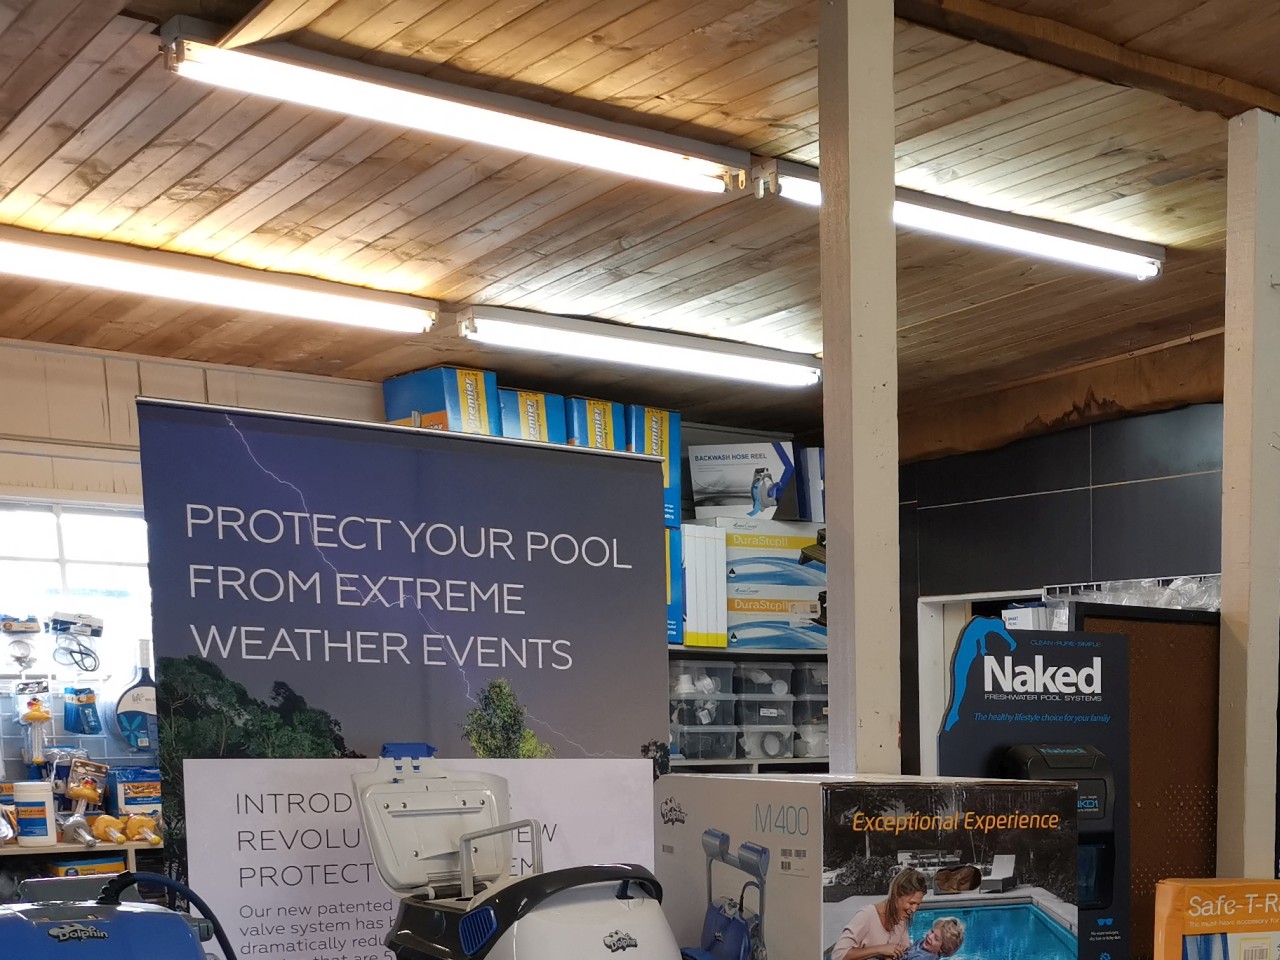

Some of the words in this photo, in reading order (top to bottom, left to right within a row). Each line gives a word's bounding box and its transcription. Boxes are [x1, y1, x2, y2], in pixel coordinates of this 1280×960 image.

[464, 377, 477, 428] Premier
[525, 399, 537, 440] remier
[593, 407, 603, 448] remier
[649, 415, 660, 456] remier
[694, 454, 731, 462] BACKWASH
[186, 503, 391, 552] PROTECT
[399, 520, 513, 561] YOUR
[526, 531, 633, 570] POOL
[189, 564, 321, 606] FROM
[336, 573, 526, 616] EXTREME
[189, 624, 410, 665] WEATHER
[423, 634, 573, 671] EVENTS
[984, 654, 1102, 694] Naked
[974, 712, 988, 721] The
[988, 712, 1014, 723] healthy
[1014, 713, 1040, 722] lifestyle
[1041, 713, 1064, 721] choice
[1064, 714, 1074, 722] for
[1073, 715, 1089, 723] your
[1089, 714, 1111, 723] family
[235, 792, 353, 815] INTROD
[852, 811, 959, 837] Exceptional
[964, 810, 1060, 835] Experience
[237, 829, 360, 852] REVOLU
[239, 863, 375, 888] PROTECT
[239, 904, 273, 919] Our
[277, 906, 312, 918] new
[317, 899, 393, 918] patented
[58, 927, 109, 942] Dolphin
[239, 921, 286, 937] valve
[290, 920, 350, 937] system
[356, 918, 384, 930] has
[240, 936, 347, 955] dramatically
[352, 934, 384, 948] redu
[610, 937, 638, 951] Dolphin
